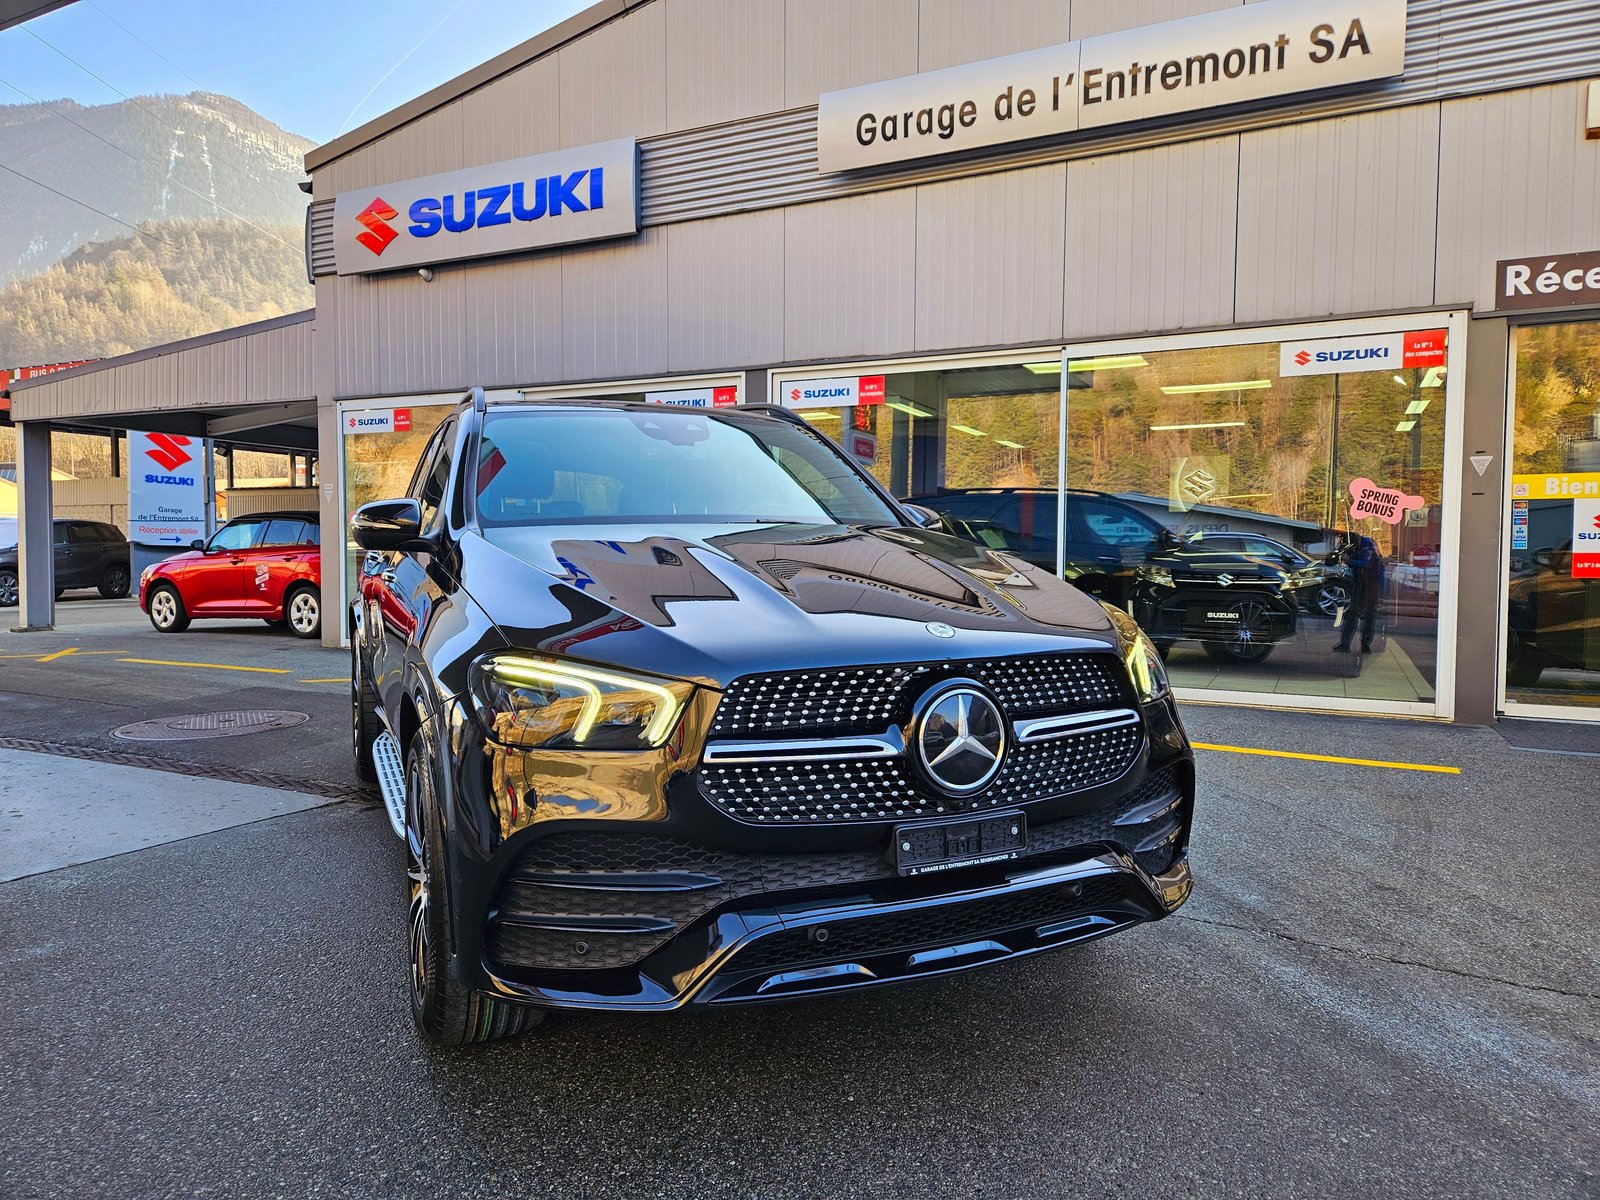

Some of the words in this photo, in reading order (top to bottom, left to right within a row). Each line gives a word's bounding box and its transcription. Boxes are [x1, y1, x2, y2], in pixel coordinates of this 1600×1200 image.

[855, 99, 977, 146] Garage
[994, 85, 1036, 121] de
[1052, 34, 1290, 112] l'Entremont
[1308, 18, 1373, 64] SA
[407, 167, 604, 238] SUZUKI
[1315, 347, 1389, 362] SUZUKI
[804, 388, 850, 398] SUZUKI
[358, 418, 388, 426] SUZUKI
[145, 474, 194, 486] SUZUKI
[1545, 477, 1599, 495] Bien
[1361, 489, 1399, 506] SPRING
[158, 506, 182, 514] Garage
[1357, 500, 1395, 517] BONUS
[139, 525, 177, 535] Réception
[920, 865, 939, 873] GARAGE
